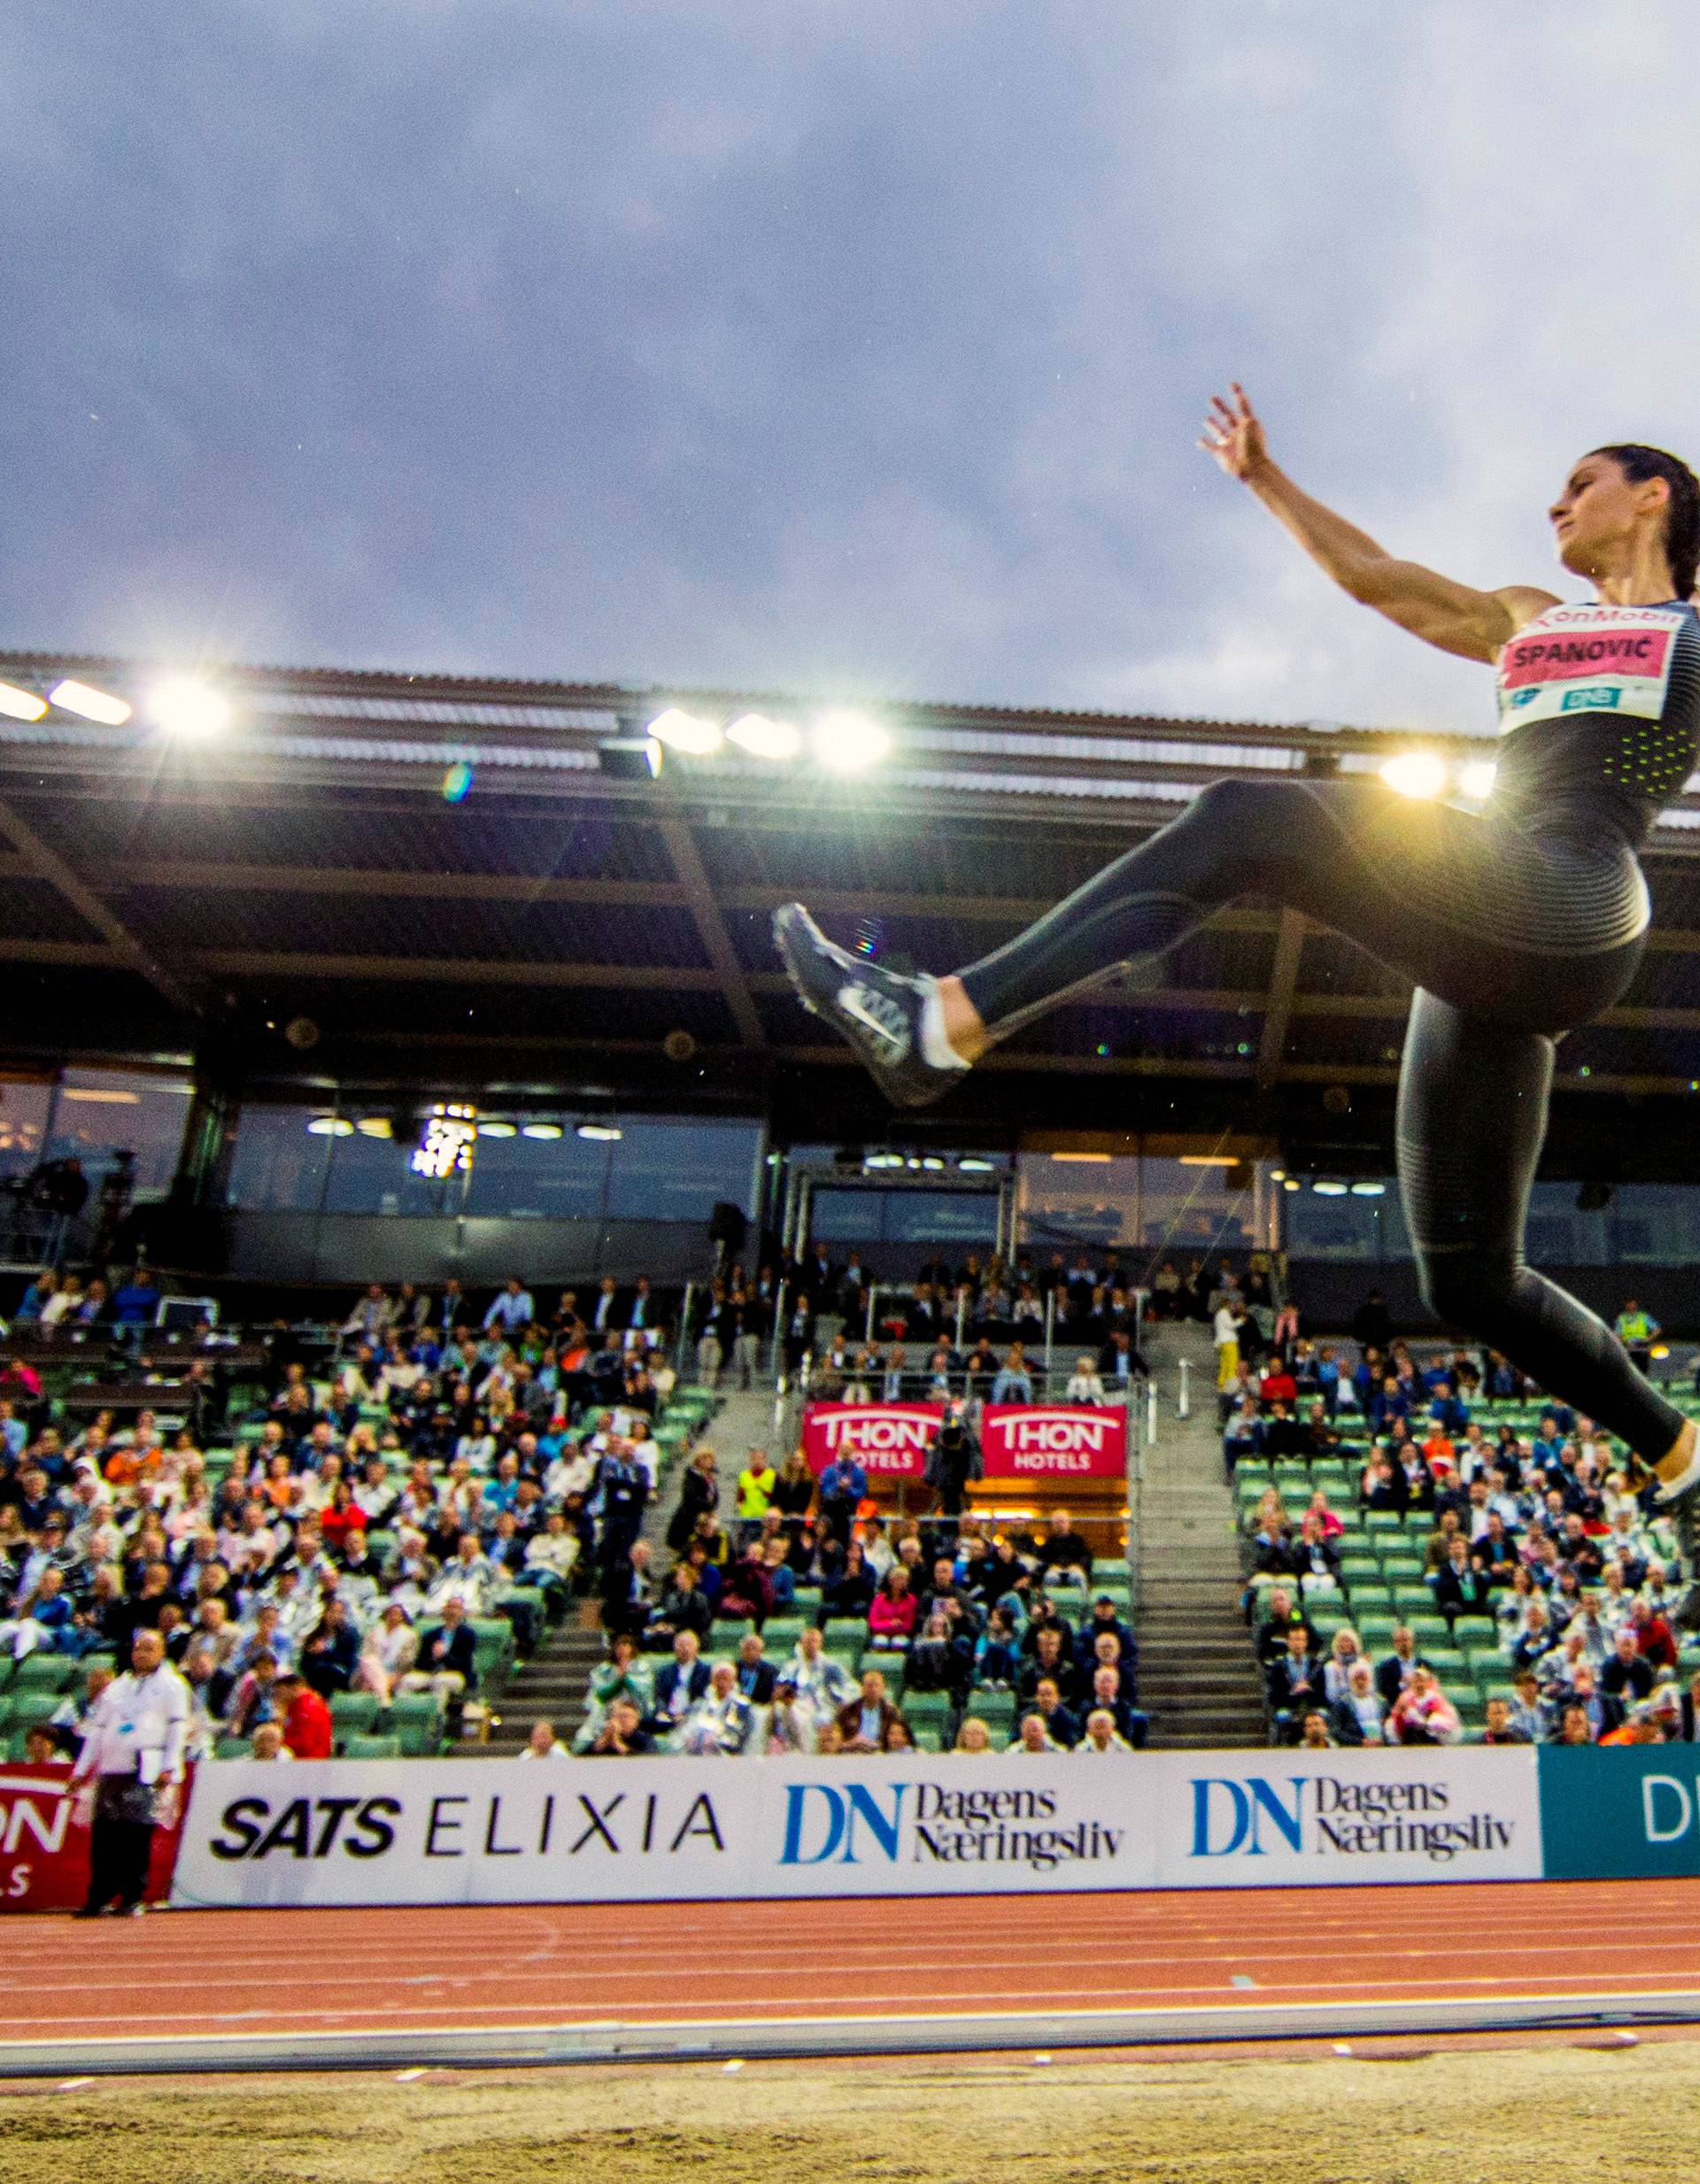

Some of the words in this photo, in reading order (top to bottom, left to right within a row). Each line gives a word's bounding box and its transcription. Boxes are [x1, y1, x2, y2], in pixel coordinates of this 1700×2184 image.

[811, 1408, 942, 1449] THON
[989, 1410, 1121, 1451] THON
[1015, 1452, 1092, 1471] HOTELS
[916, 1783, 1056, 1829] Dagens
[1188, 1777, 1310, 1857] DN
[1315, 1777, 1449, 1820] Dagens
[1642, 1774, 1700, 1841] D
[210, 1797, 401, 1858] SATS
[424, 1793, 724, 1856] ELIXIA
[779, 1783, 911, 1864] DN
[915, 1822, 1123, 1871] Næringsliv
[1317, 1815, 1515, 1861] Næringsliv
